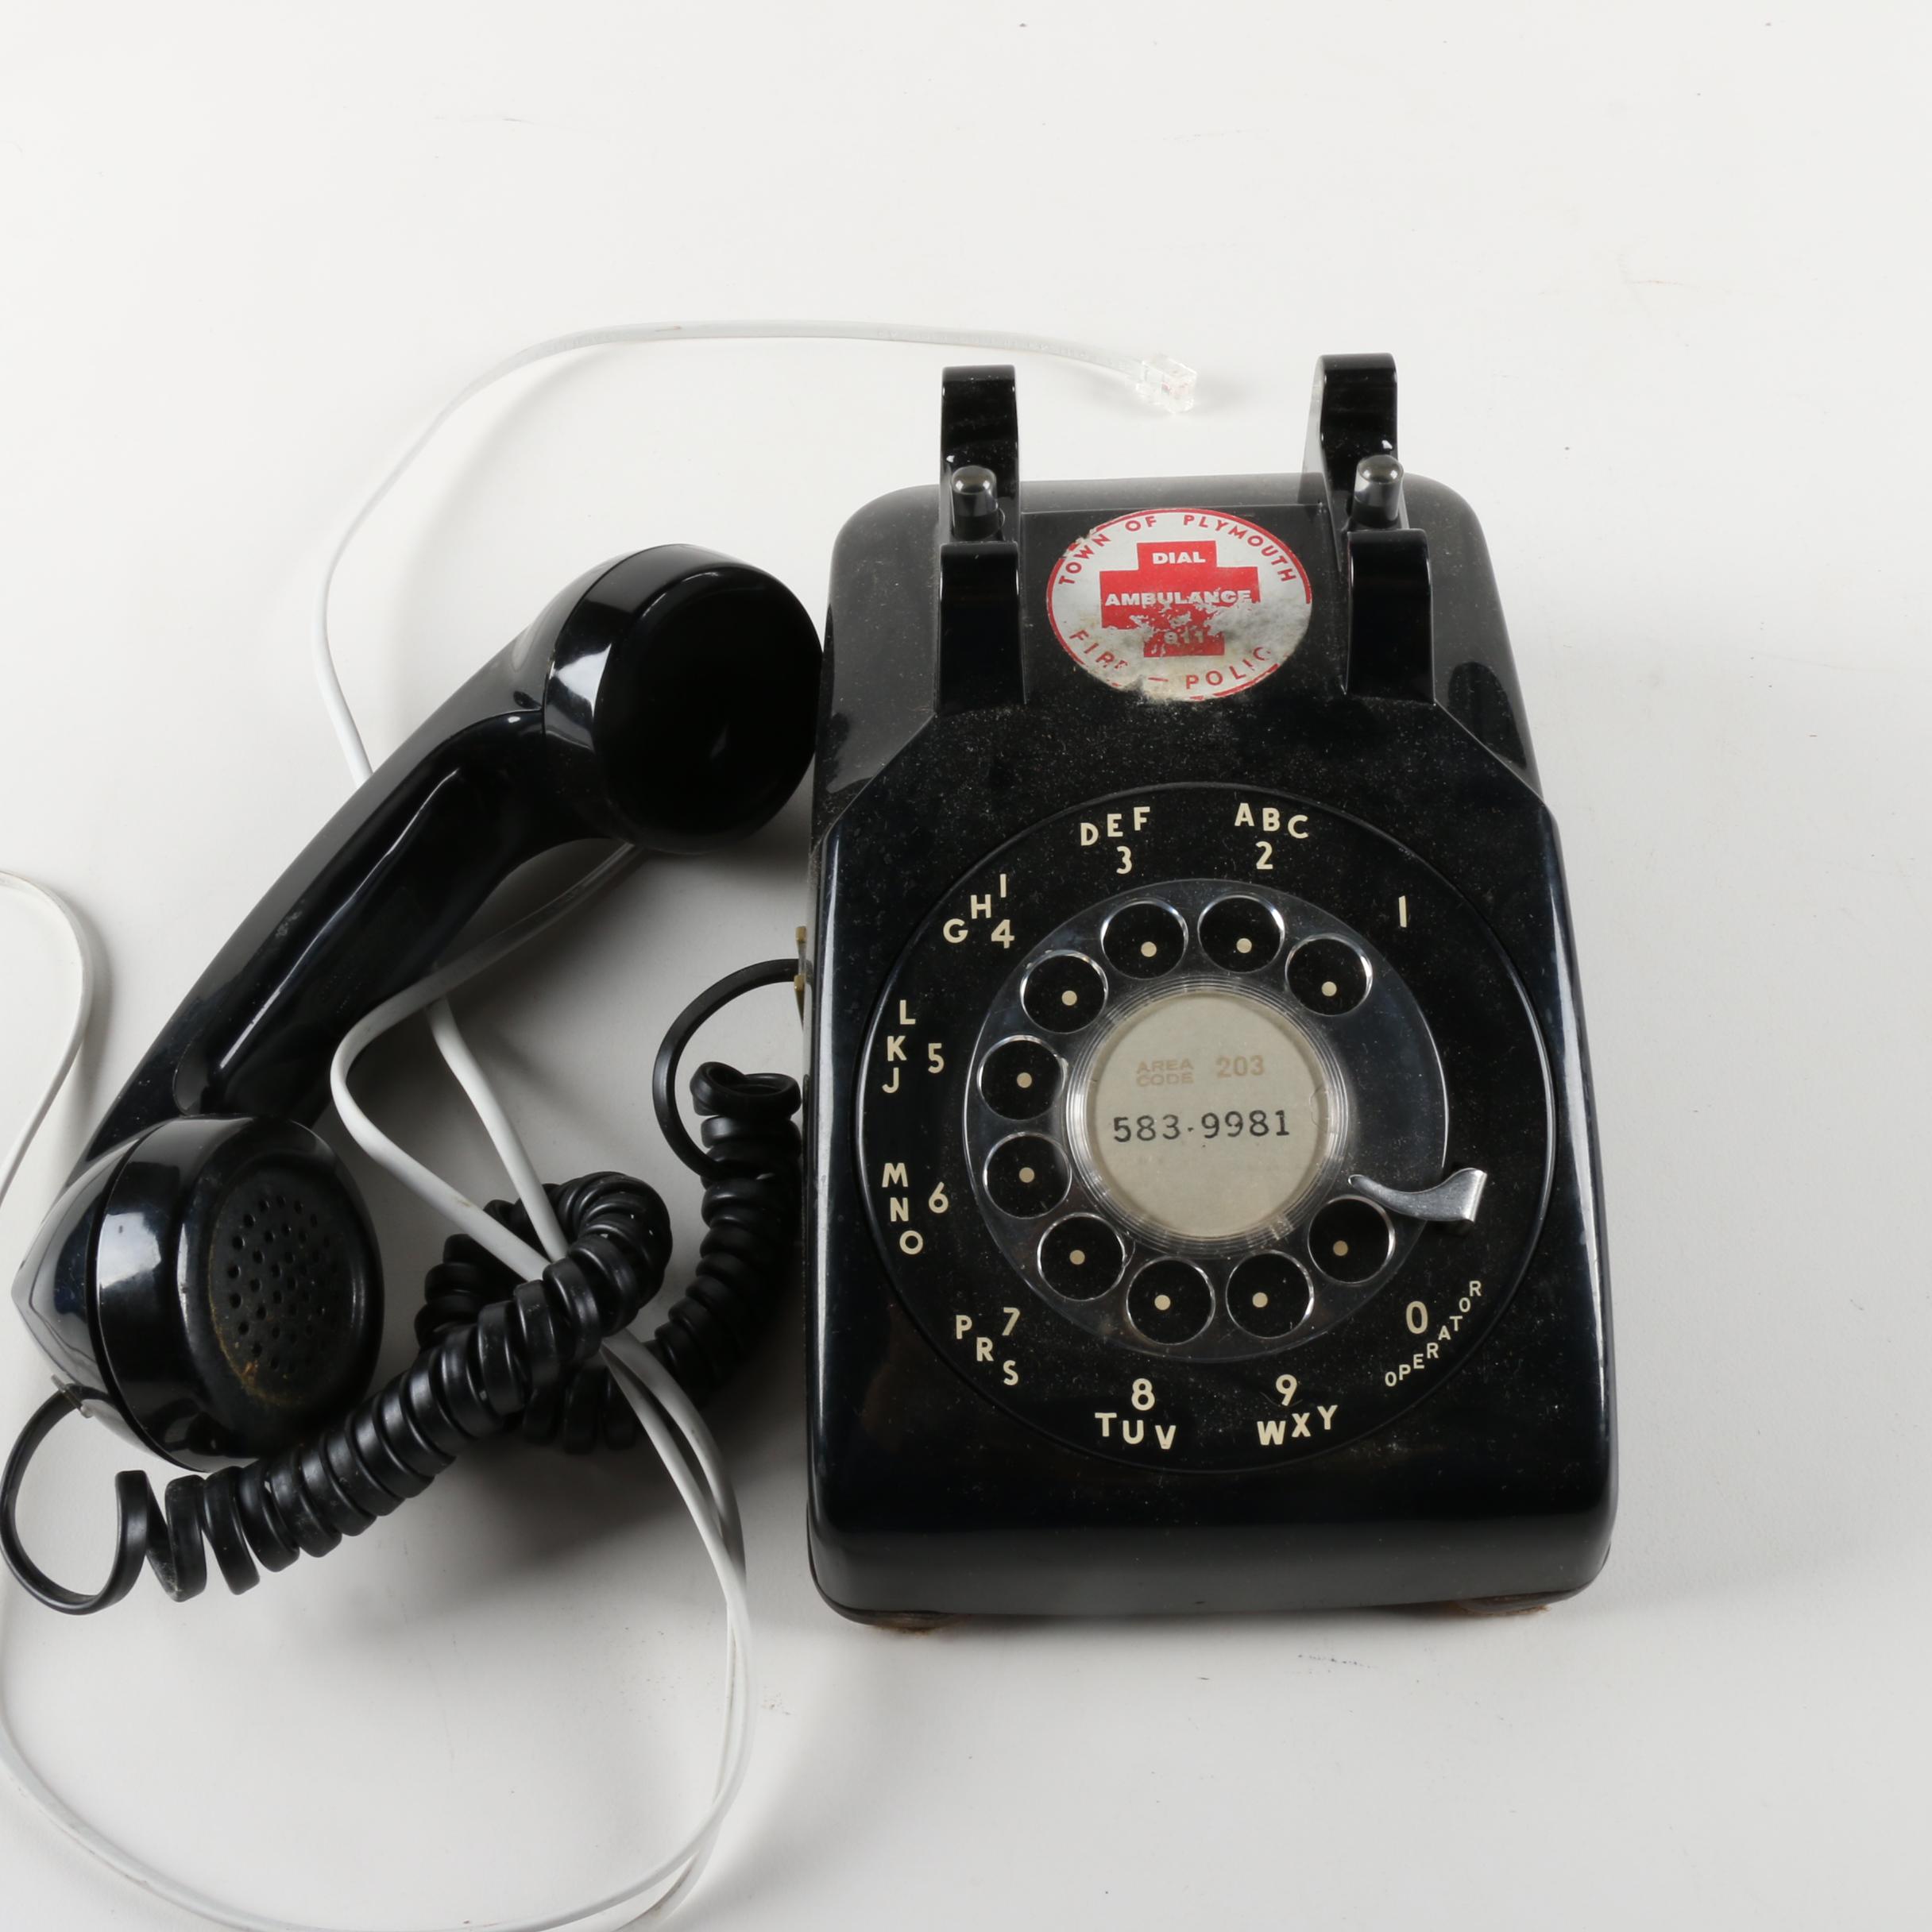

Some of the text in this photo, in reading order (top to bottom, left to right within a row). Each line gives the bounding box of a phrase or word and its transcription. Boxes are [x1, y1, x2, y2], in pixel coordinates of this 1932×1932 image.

[1059, 515, 1296, 585] TOWN OF PLYMOUTH
[1152, 552, 1206, 565] DIAL
[1105, 589, 1252, 606] AMBULANCE
[1186, 646, 1272, 690] POLIC
[1235, 803, 1308, 838] ABC
[1117, 846, 1133, 874] 3
[1256, 841, 1273, 870] 2
[991, 919, 1015, 949] 4
[928, 1043, 945, 1073] 5
[1136, 1058, 1194, 1073] AREA
[1215, 1055, 1264, 1078] 203
[1136, 1072, 1194, 1087] CODE
[929, 1182, 949, 1213] 6
[1002, 1308, 1020, 1335] 7
[1406, 1301, 1428, 1334] 0
[1385, 1281, 1482, 1386] OPERATOR
[1131, 1378, 1155, 1410] 8
[1276, 1374, 1297, 1406] 9
